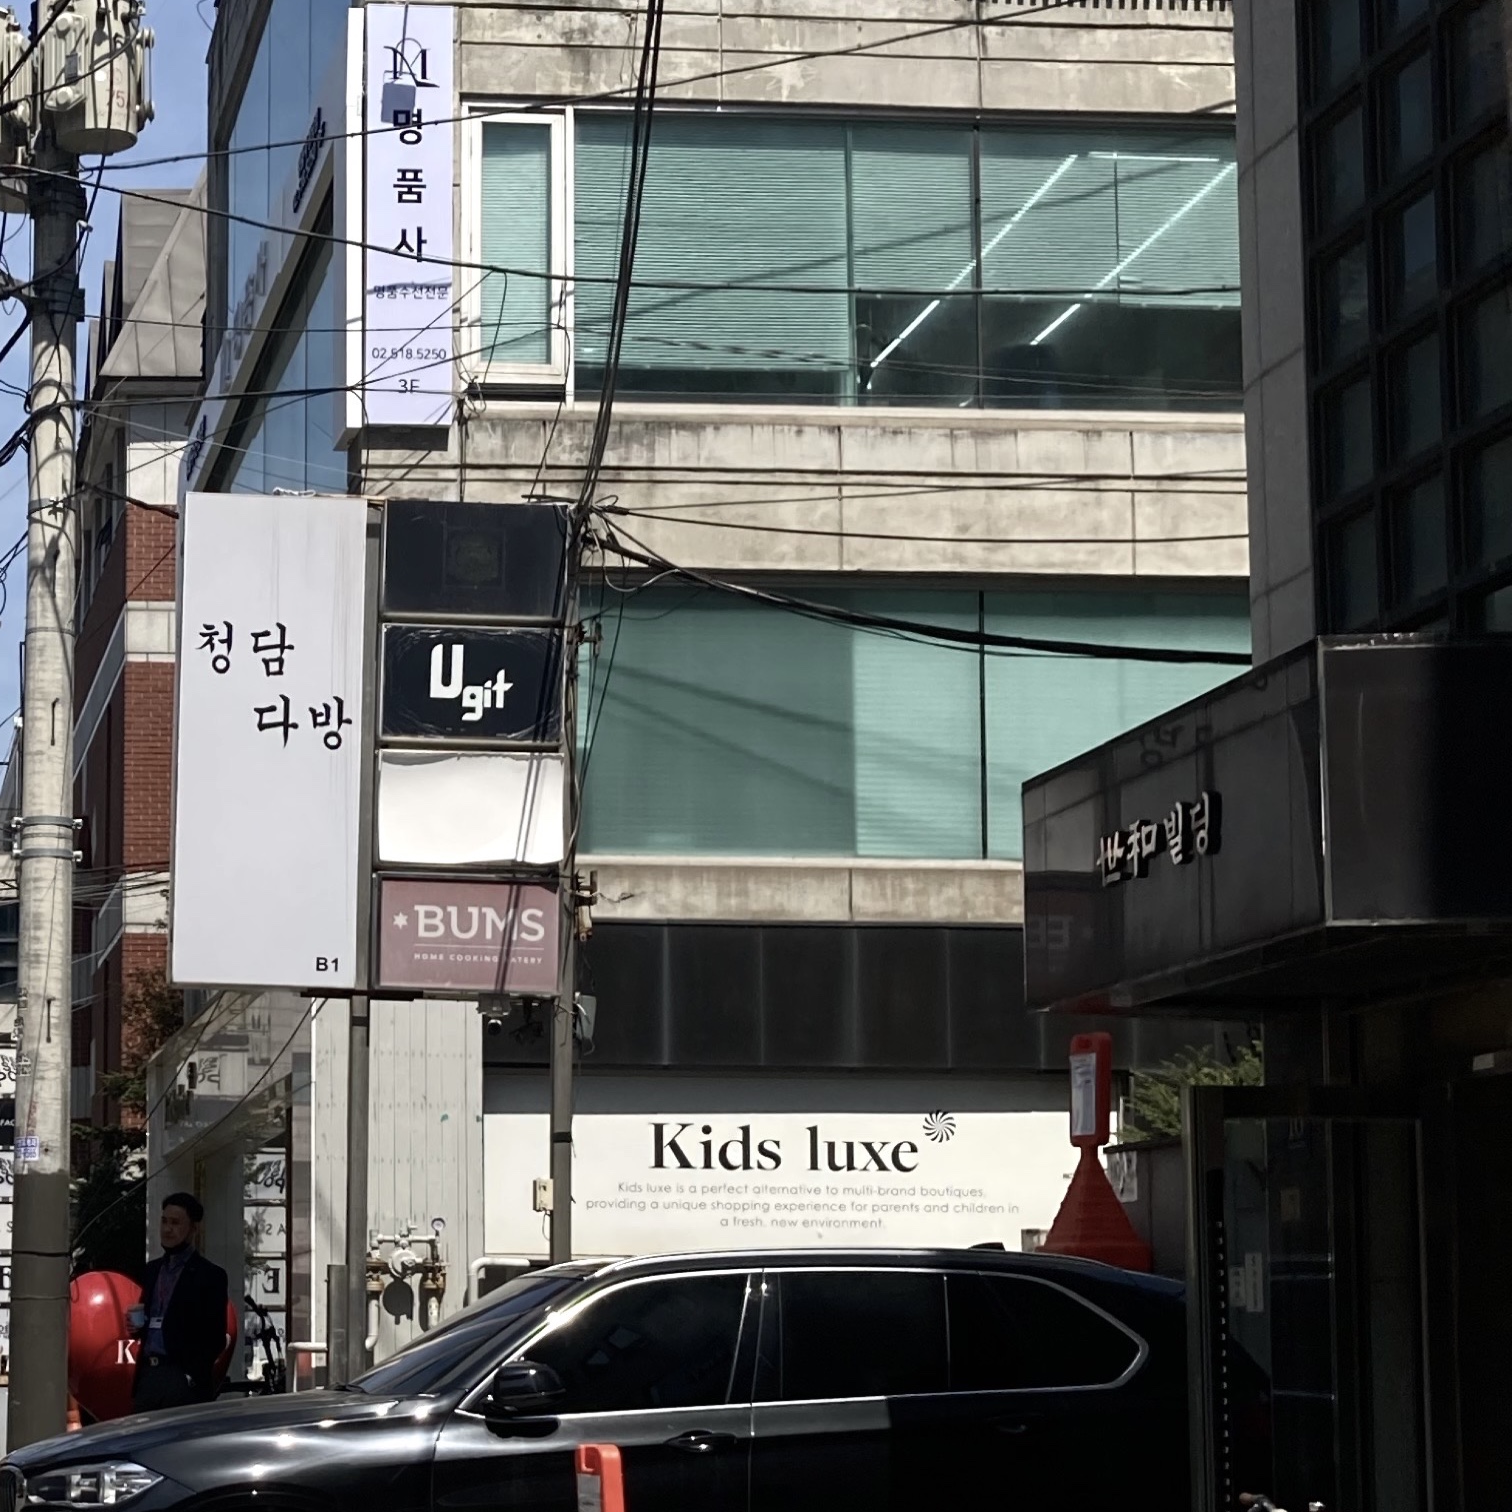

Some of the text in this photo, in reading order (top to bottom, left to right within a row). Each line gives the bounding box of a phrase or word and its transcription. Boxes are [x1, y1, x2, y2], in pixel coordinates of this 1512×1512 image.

[195, 620, 295, 678] 청담
[429, 643, 514, 722] Ugit
[253, 694, 353, 751] 다방
[413, 903, 546, 942] BUMS
[315, 957, 340, 973] B1
[414, 952, 445, 961] HOME
[449, 953, 499, 963] COOKING
[648, 1122, 919, 1173] Kids luxe
[617, 1182, 643, 1193] Kids
[646, 1183, 672, 1194] luxe
[676, 1183, 685, 1194] is
[688, 1185, 697, 1194] a
[701, 1184, 749, 1197] perfect
[752, 1184, 822, 1195] alternative
[825, 1185, 839, 1195] to
[842, 1185, 916, 1197] multi-brand
[585, 1198, 1020, 1214] providing a unique shopping experience for parents and children in
[720, 1218, 729, 1227] a
[770, 1218, 798, 1228] new
